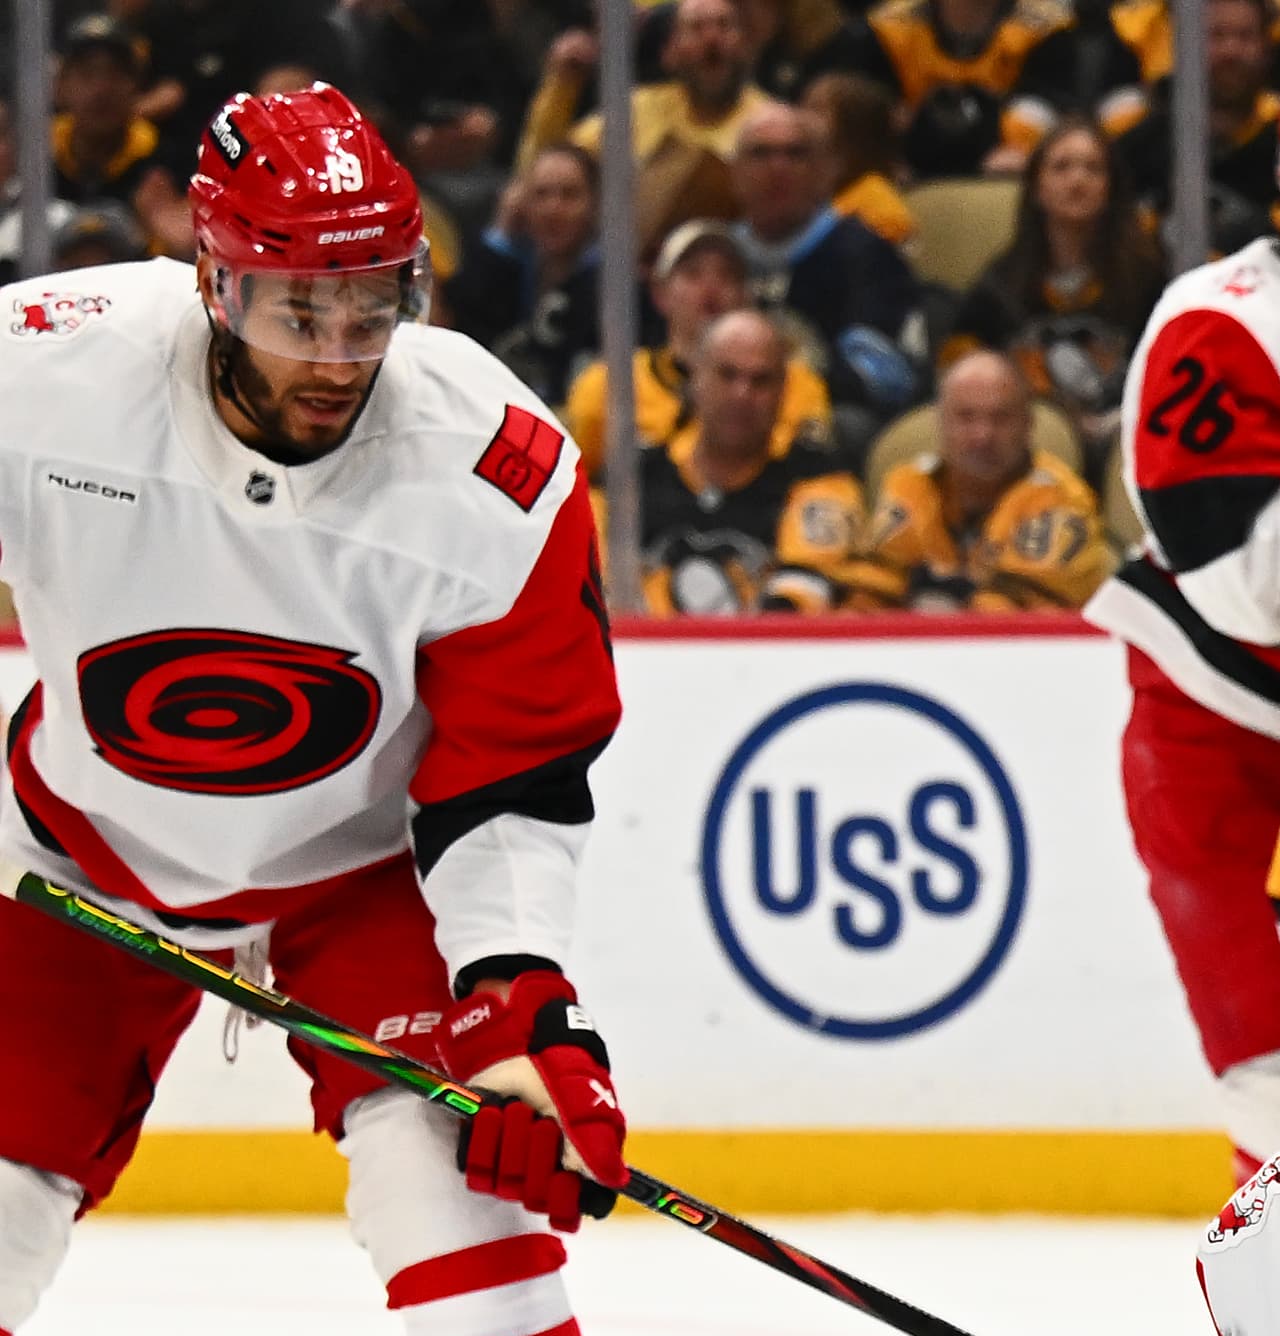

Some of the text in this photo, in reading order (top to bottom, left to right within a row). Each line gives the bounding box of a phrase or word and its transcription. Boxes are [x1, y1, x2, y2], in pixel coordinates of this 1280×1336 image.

[325, 152, 364, 195] 19
[318, 225, 385, 245] BAUER
[1146, 356, 1237, 455] 26
[48, 473, 137, 504] NUCOR
